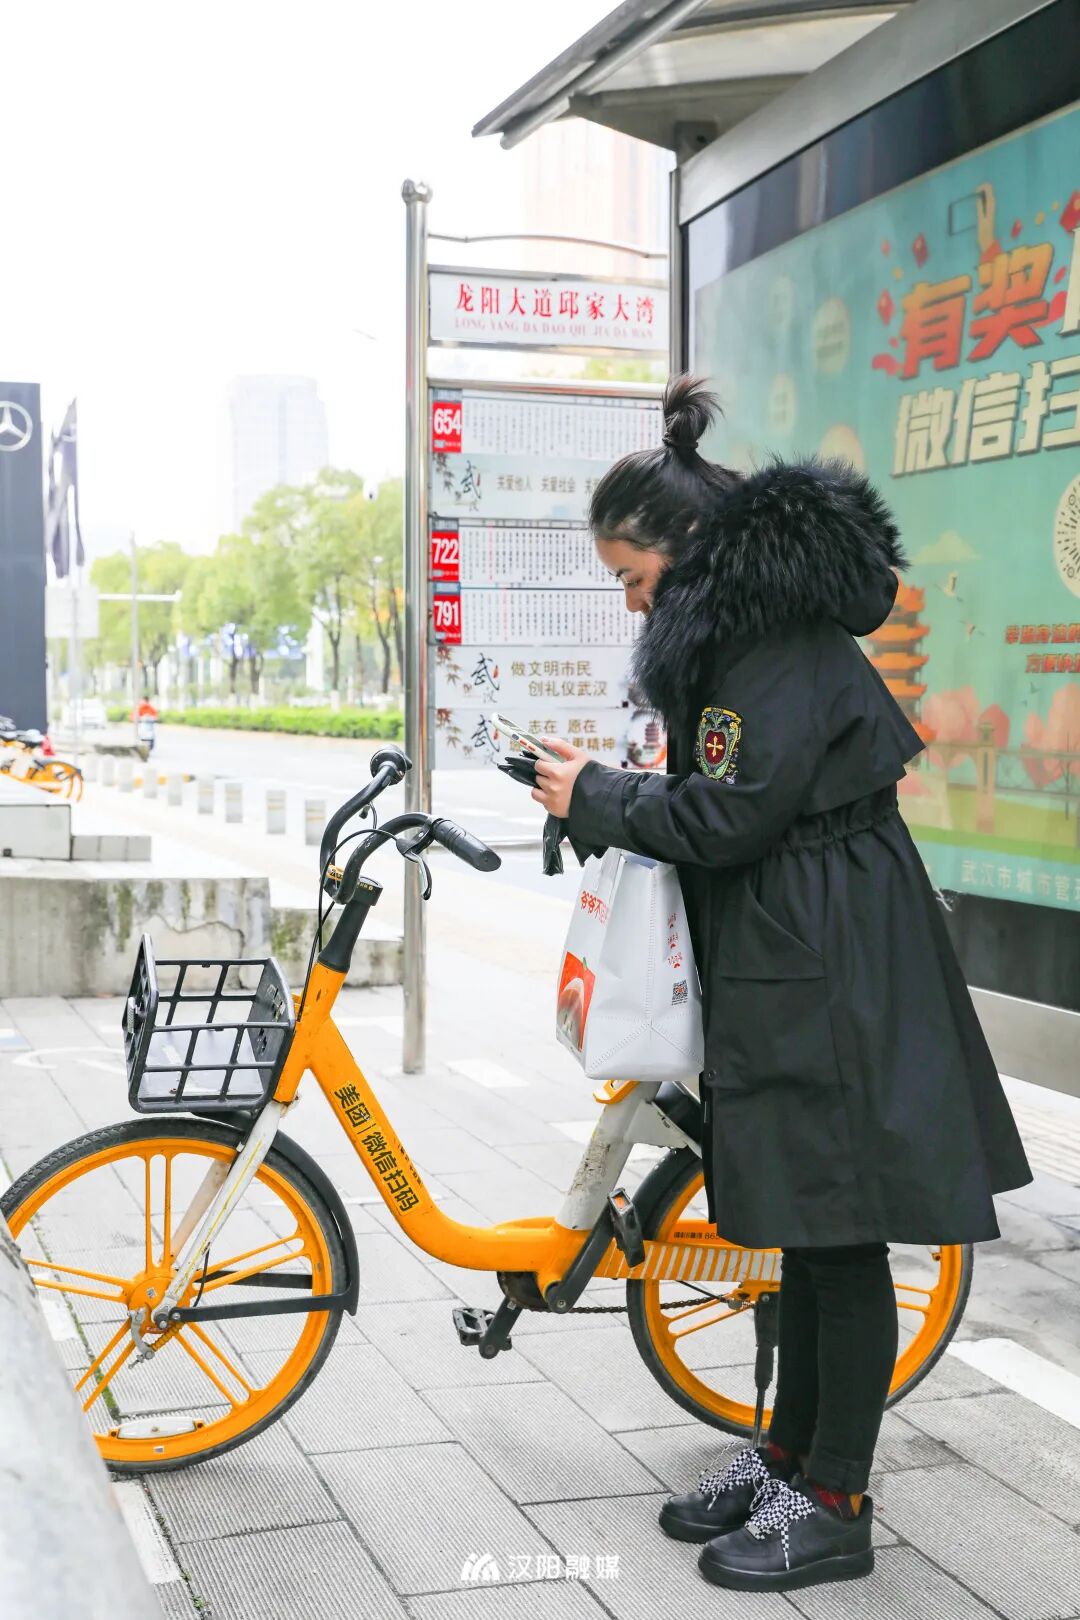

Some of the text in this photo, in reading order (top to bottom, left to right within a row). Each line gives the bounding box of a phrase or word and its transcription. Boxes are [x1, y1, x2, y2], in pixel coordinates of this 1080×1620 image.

[456, 283, 654, 325] 龙阳大道邱家大湾
[900, 226, 1080, 381] 有奖
[434, 408, 462, 435] 654
[432, 538, 459, 564] 722
[434, 601, 460, 626] 791
[511, 661, 592, 677] 做文明市民
[528, 681, 608, 697] 创礼仪武汉
[528, 719, 558, 734] 志在
[334, 1084, 372, 1128] 美团
[361, 1131, 420, 1212] 微信扫码
